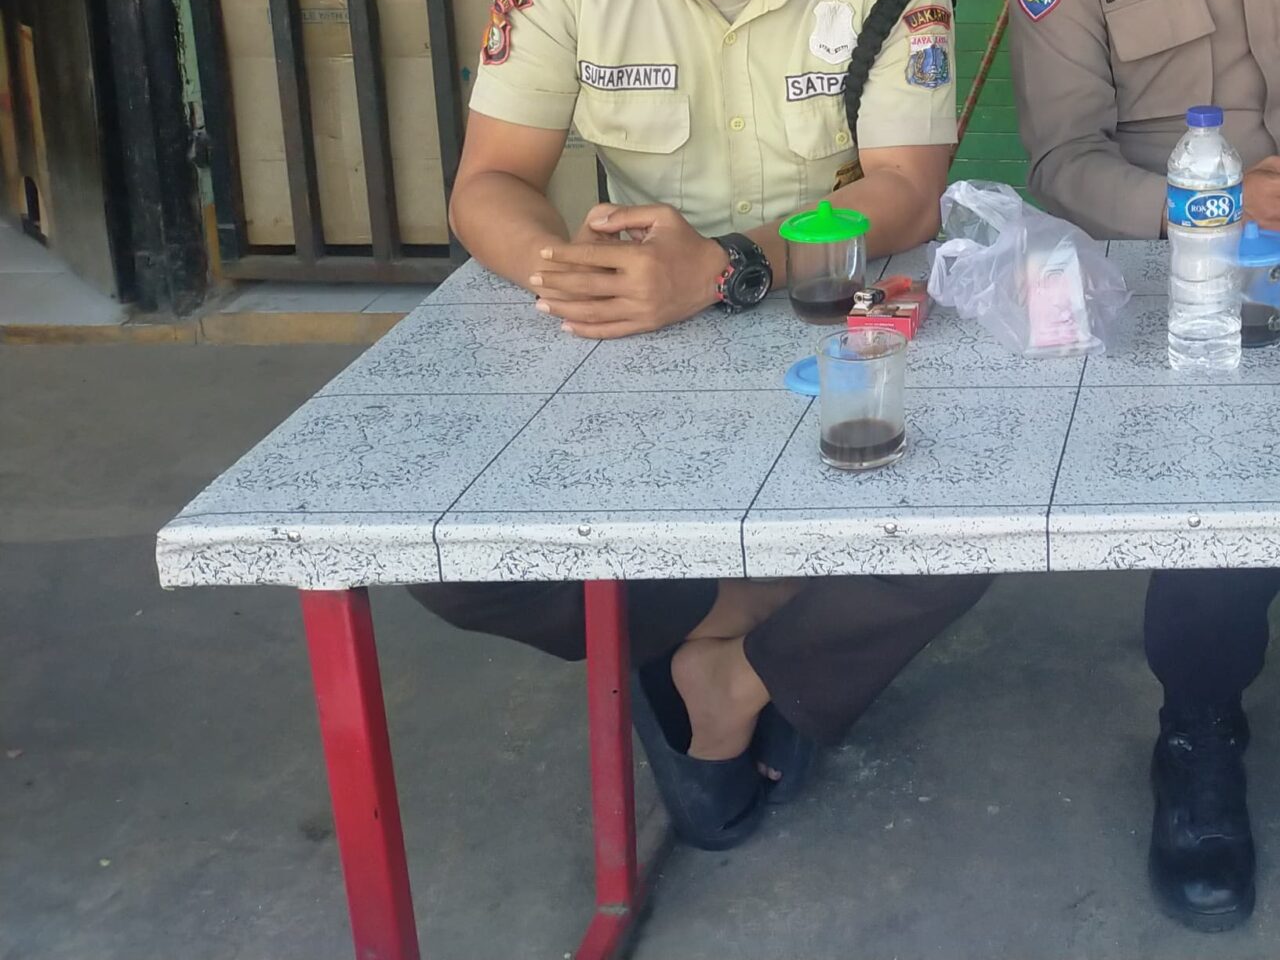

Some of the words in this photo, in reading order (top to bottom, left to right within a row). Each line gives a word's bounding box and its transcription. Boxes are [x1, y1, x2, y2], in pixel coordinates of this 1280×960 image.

[584, 65, 673, 89] SUHARYANTO
[791, 76, 849, 97] SATP
[1206, 197, 1230, 218] 88
